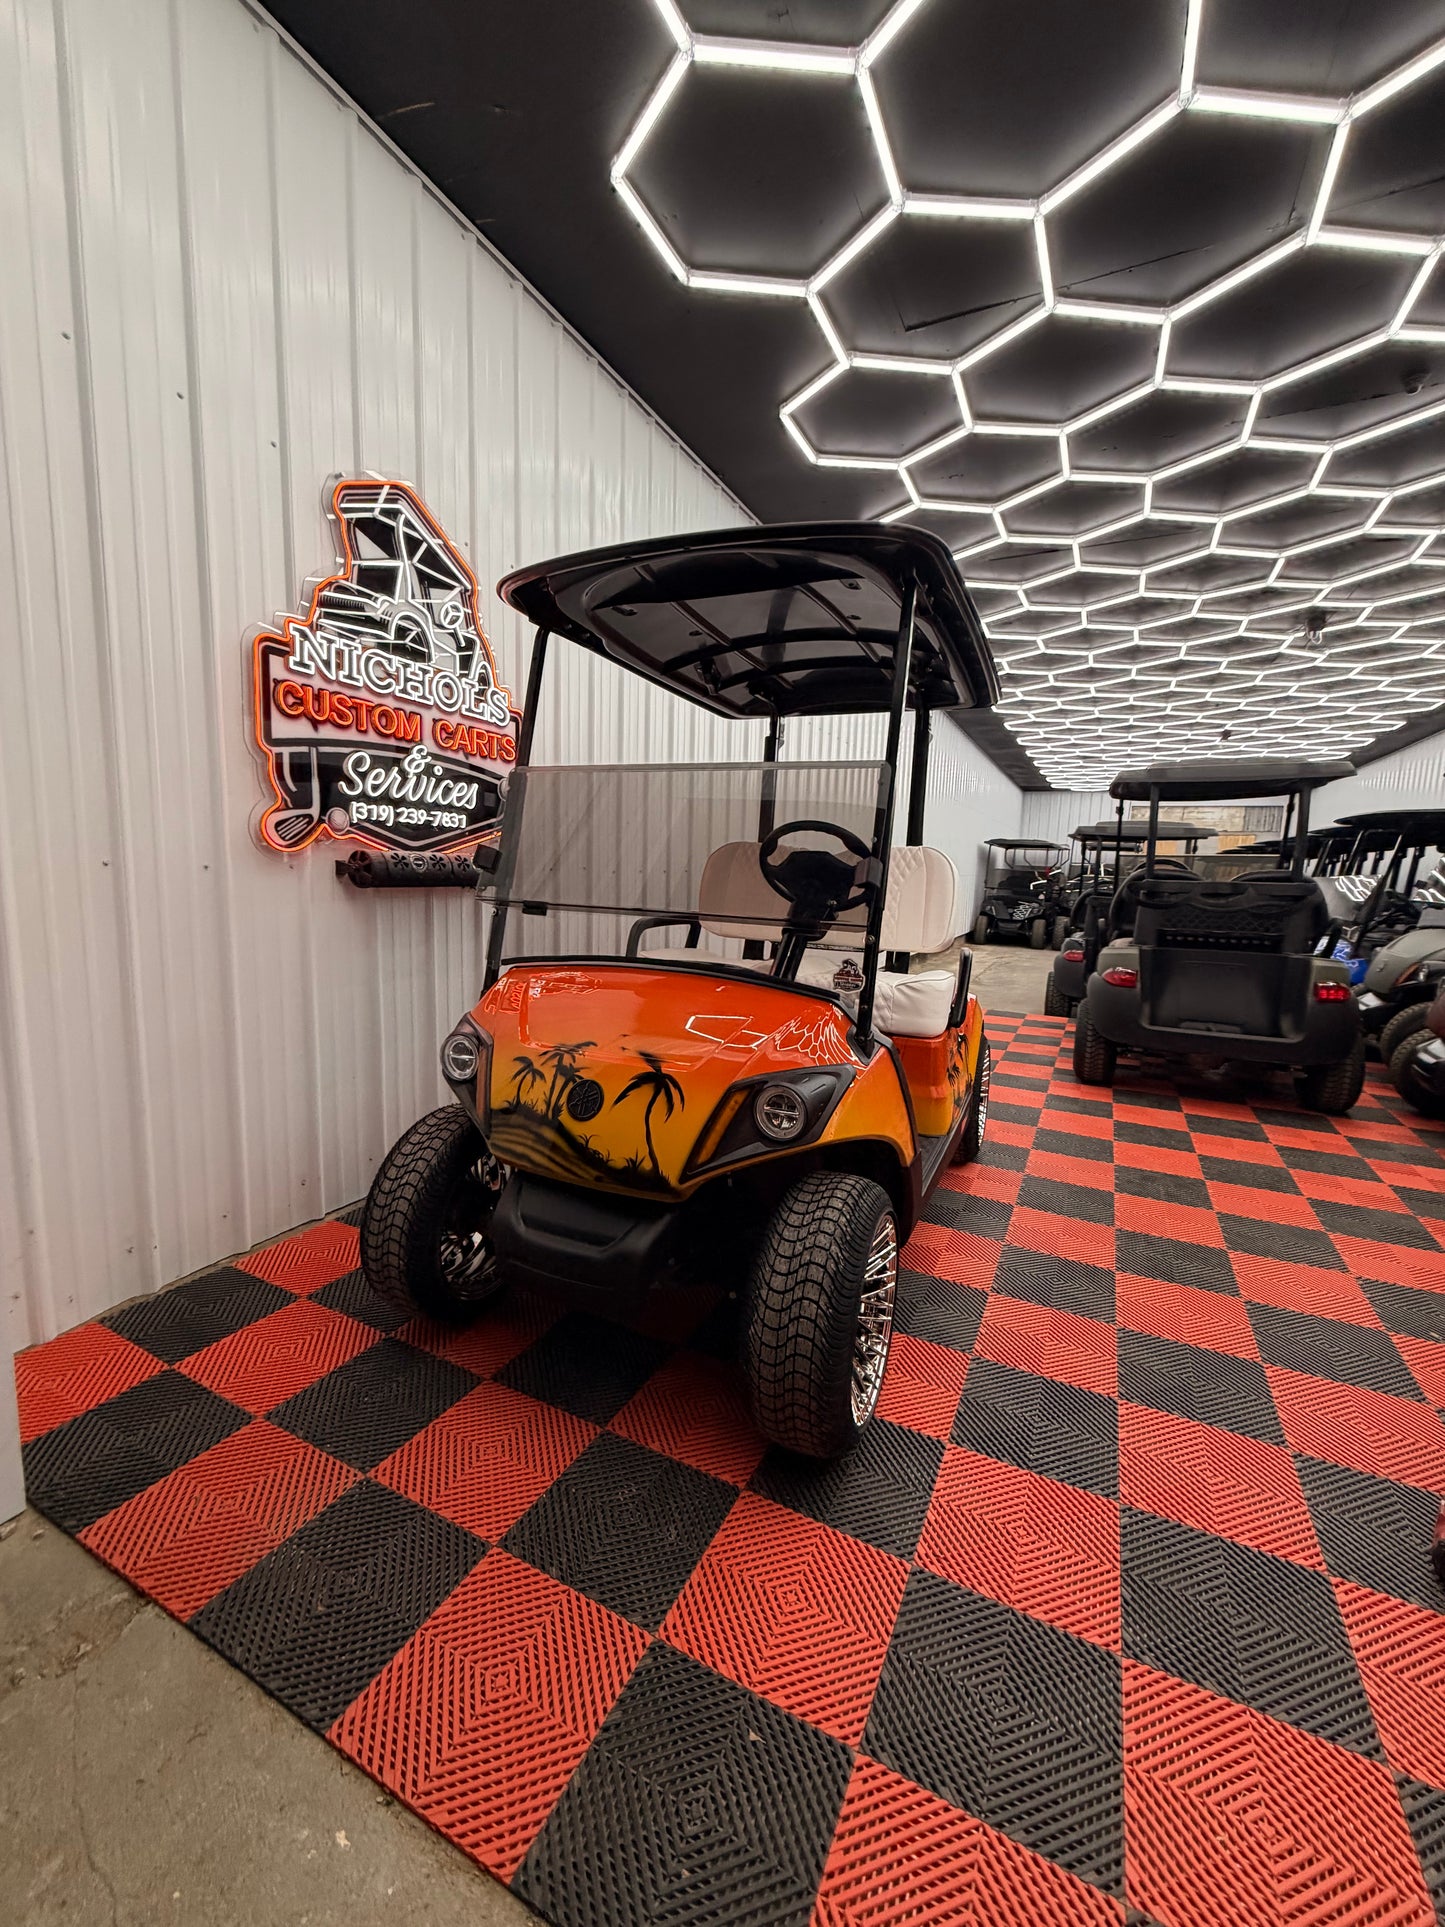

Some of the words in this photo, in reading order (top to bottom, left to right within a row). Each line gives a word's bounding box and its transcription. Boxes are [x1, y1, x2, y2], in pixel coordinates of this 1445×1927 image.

[289, 622, 511, 727] NICHOLS
[275, 680, 422, 742] CUSTOM
[433, 718, 517, 762] CARTS
[338, 751, 479, 809] Services
[403, 744, 432, 778] &
[351, 801, 394, 827] (319)
[396, 804, 467, 829] 239-7831
